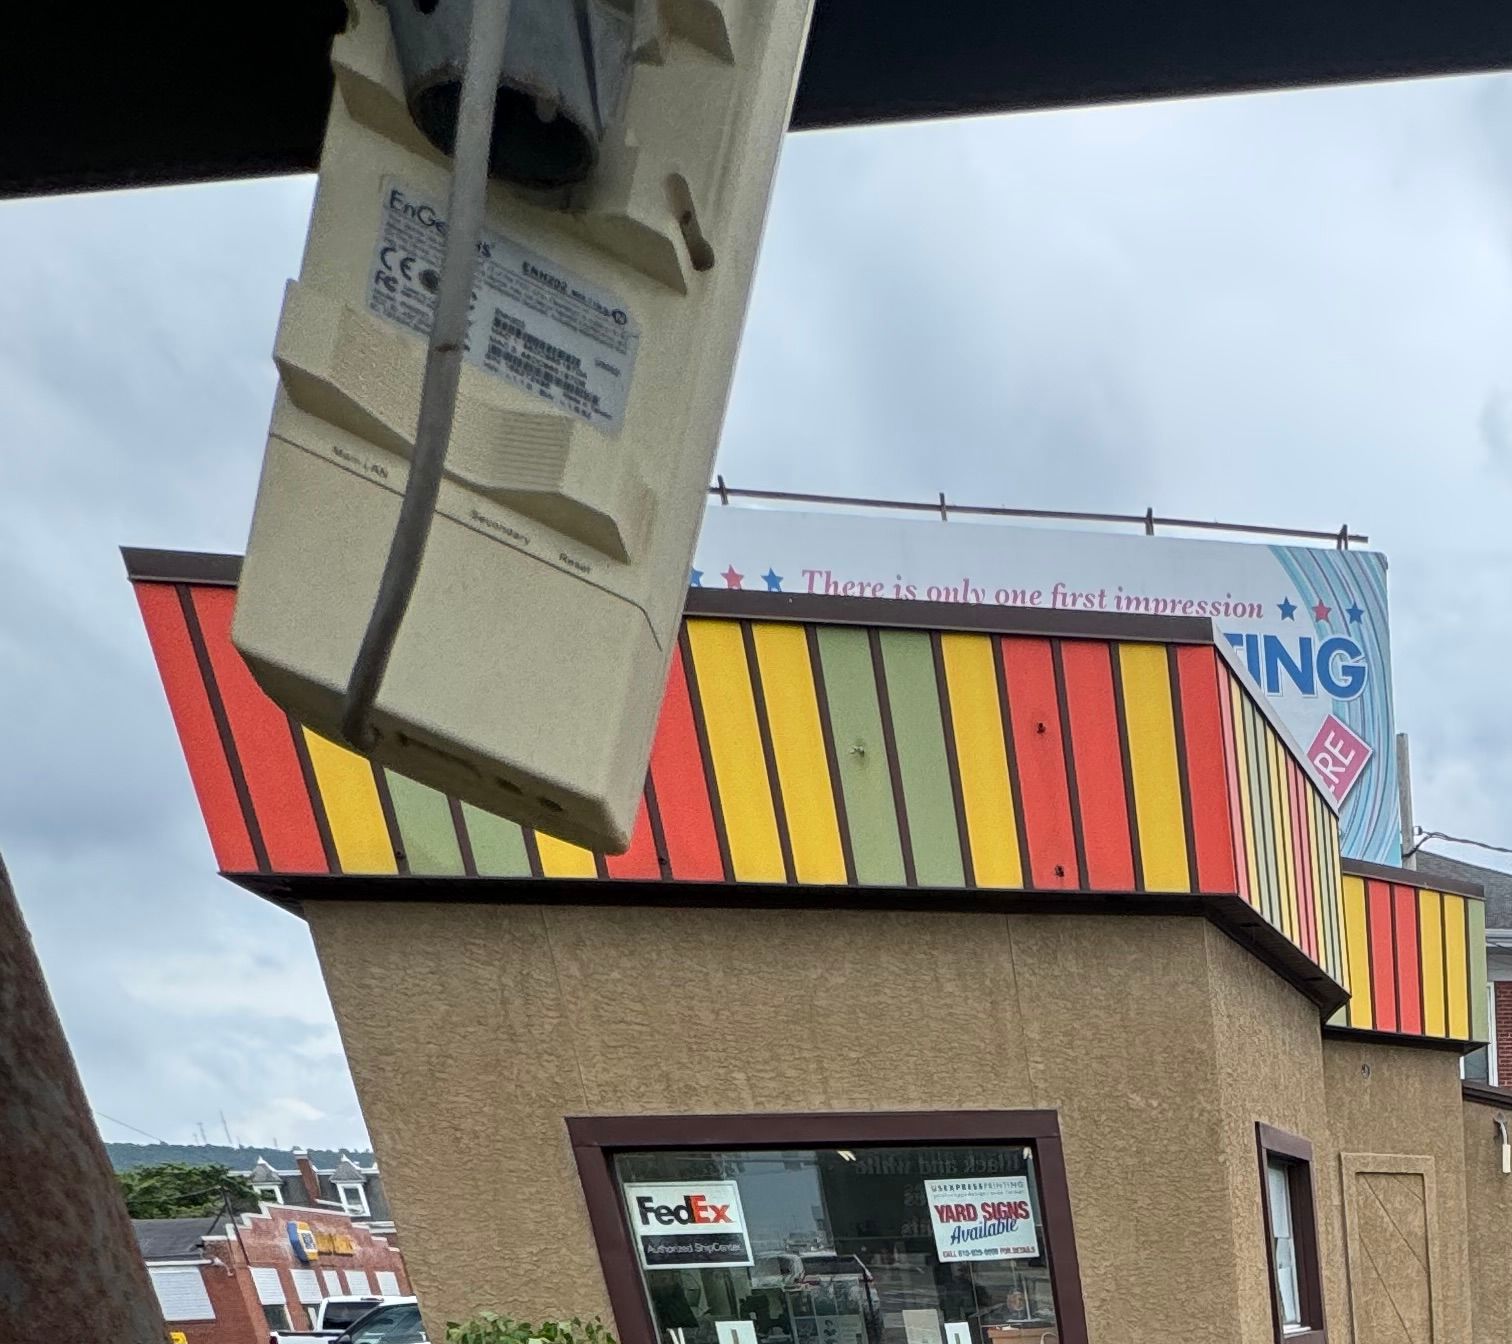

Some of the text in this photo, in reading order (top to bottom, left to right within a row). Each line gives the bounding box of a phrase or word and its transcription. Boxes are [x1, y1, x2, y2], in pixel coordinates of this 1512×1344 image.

[522, 261, 568, 295] ENH202
[471, 509, 531, 546] Secondary
[559, 553, 591, 574] Reset
[801, 569, 1263, 619] There is only one first impression
[1314, 731, 1355, 793] RE
[636, 1195, 734, 1225] FedEx
[934, 1201, 1030, 1223] YARD SIGNS
[950, 1217, 1018, 1246] Available
[647, 1244, 693, 1254] Authorized
